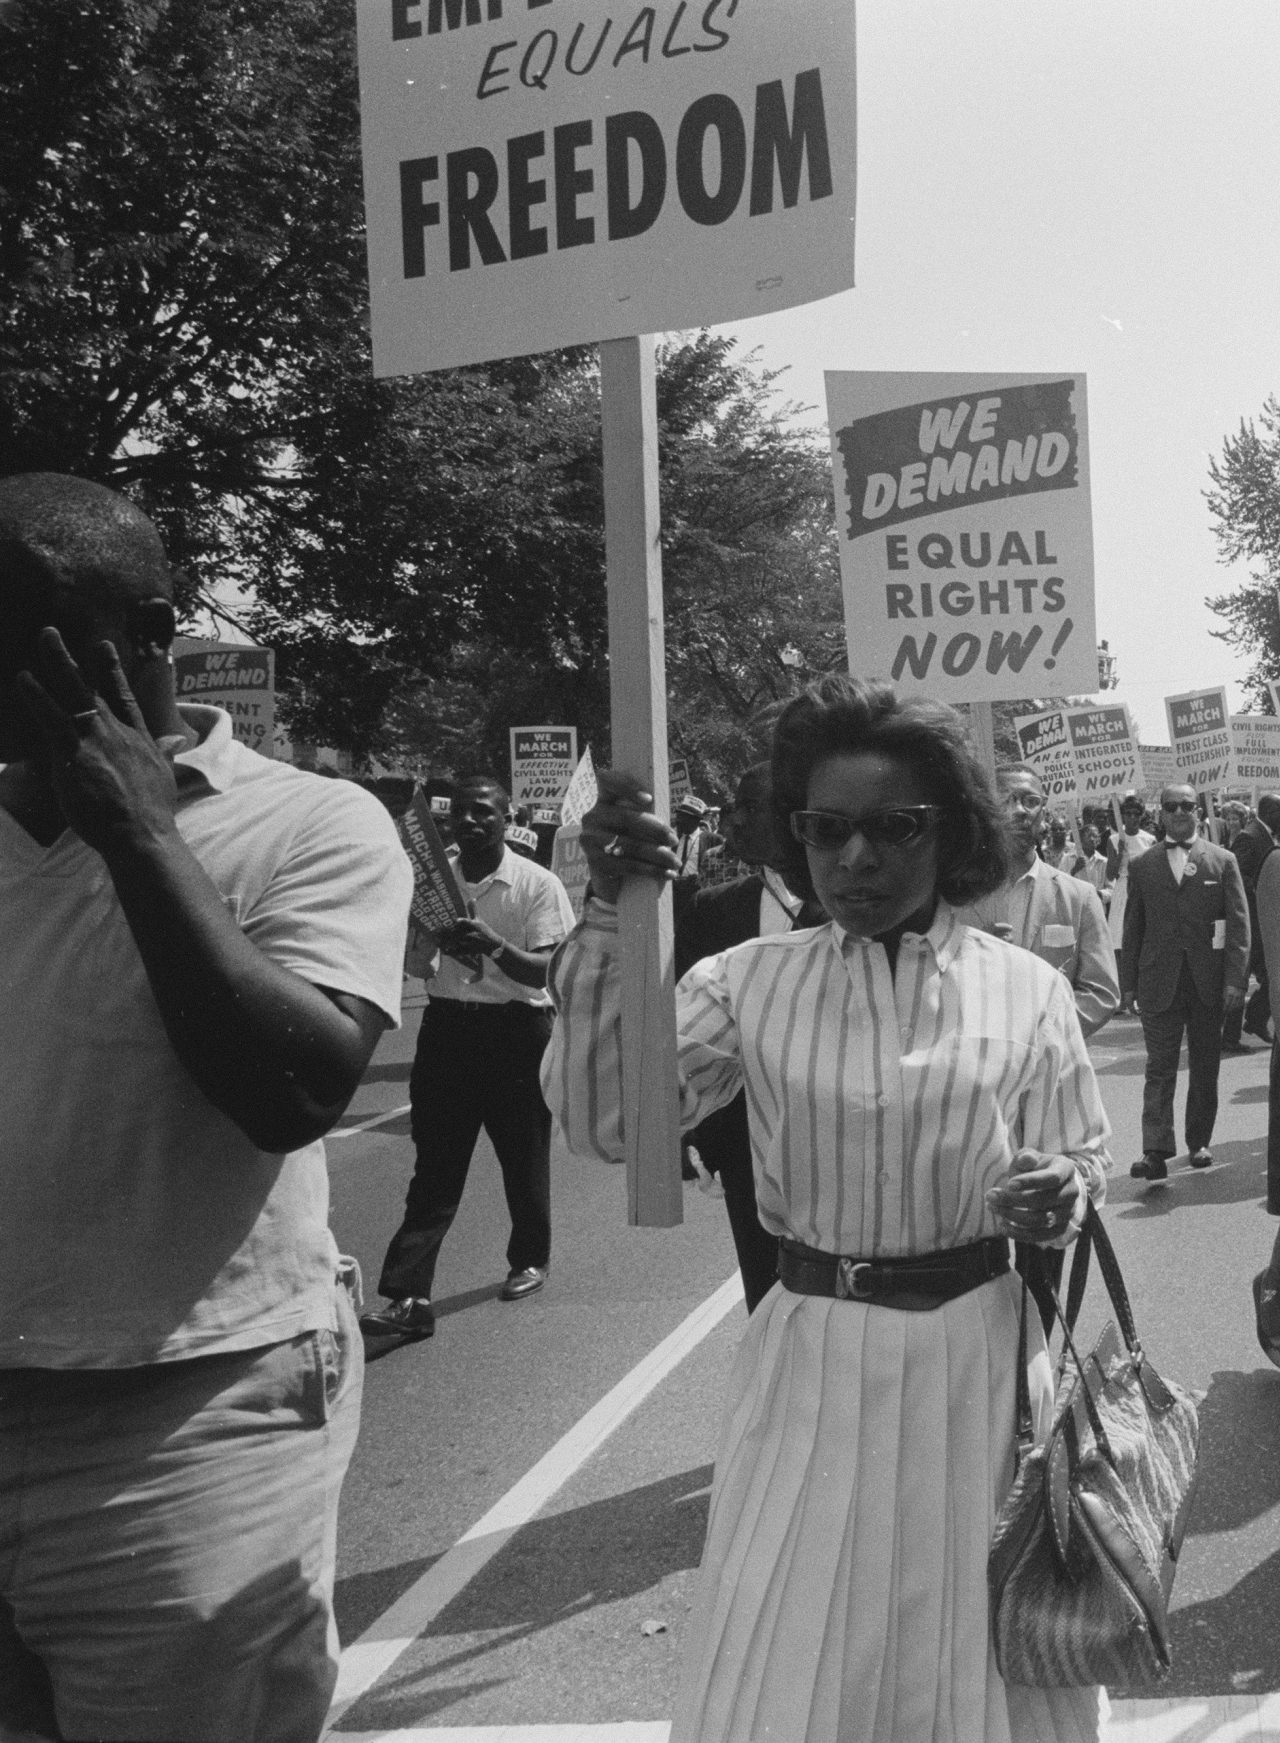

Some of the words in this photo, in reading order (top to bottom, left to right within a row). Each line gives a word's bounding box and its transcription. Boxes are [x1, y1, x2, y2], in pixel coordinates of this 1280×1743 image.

[477, 0, 738, 100] EQUALS
[400, 67, 833, 280] FREEDOM
[919, 397, 1001, 454] WE
[862, 432, 1070, 520] DEMAND
[886, 530, 1058, 570] EQUAL
[885, 577, 1066, 619] RIGHTS
[891, 617, 1074, 681] NOW!
[205, 653, 240, 670] WE
[182, 668, 266, 691] DEMAND
[1190, 699, 1205, 710] WE
[1038, 715, 1060, 734] WE
[1088, 713, 1106, 723] WE
[1177, 707, 1220, 728] MARCH
[1075, 721, 1124, 737] MARCH
[1192, 724, 1208, 733] FOR
[1232, 723, 1252, 731] CIVIL
[534, 733, 551, 741] WE
[1026, 727, 1067, 755] DEMA
[1092, 734, 1111, 742] FOR
[1176, 739, 1201, 754] FIRST
[1203, 733, 1228, 747] CLASS
[1246, 739, 1266, 747] FULL
[519, 742, 567, 752] MARCH
[1074, 742, 1133, 759] INTEGRATED
[1033, 753, 1050, 764] AN
[1055, 751, 1070, 760] EN
[1078, 756, 1135, 773] SCHOOLS
[1176, 745, 1231, 767] CITIZENSHIP
[520, 761, 569, 769] EFFECTIVE
[1044, 761, 1073, 774] POLICE
[1187, 761, 1229, 785] NOW!
[1237, 765, 1280, 778] REEDOM
[1042, 779, 1077, 796] NOW
[1086, 768, 1135, 790] NOW!
[405, 809, 432, 865] MARCH
